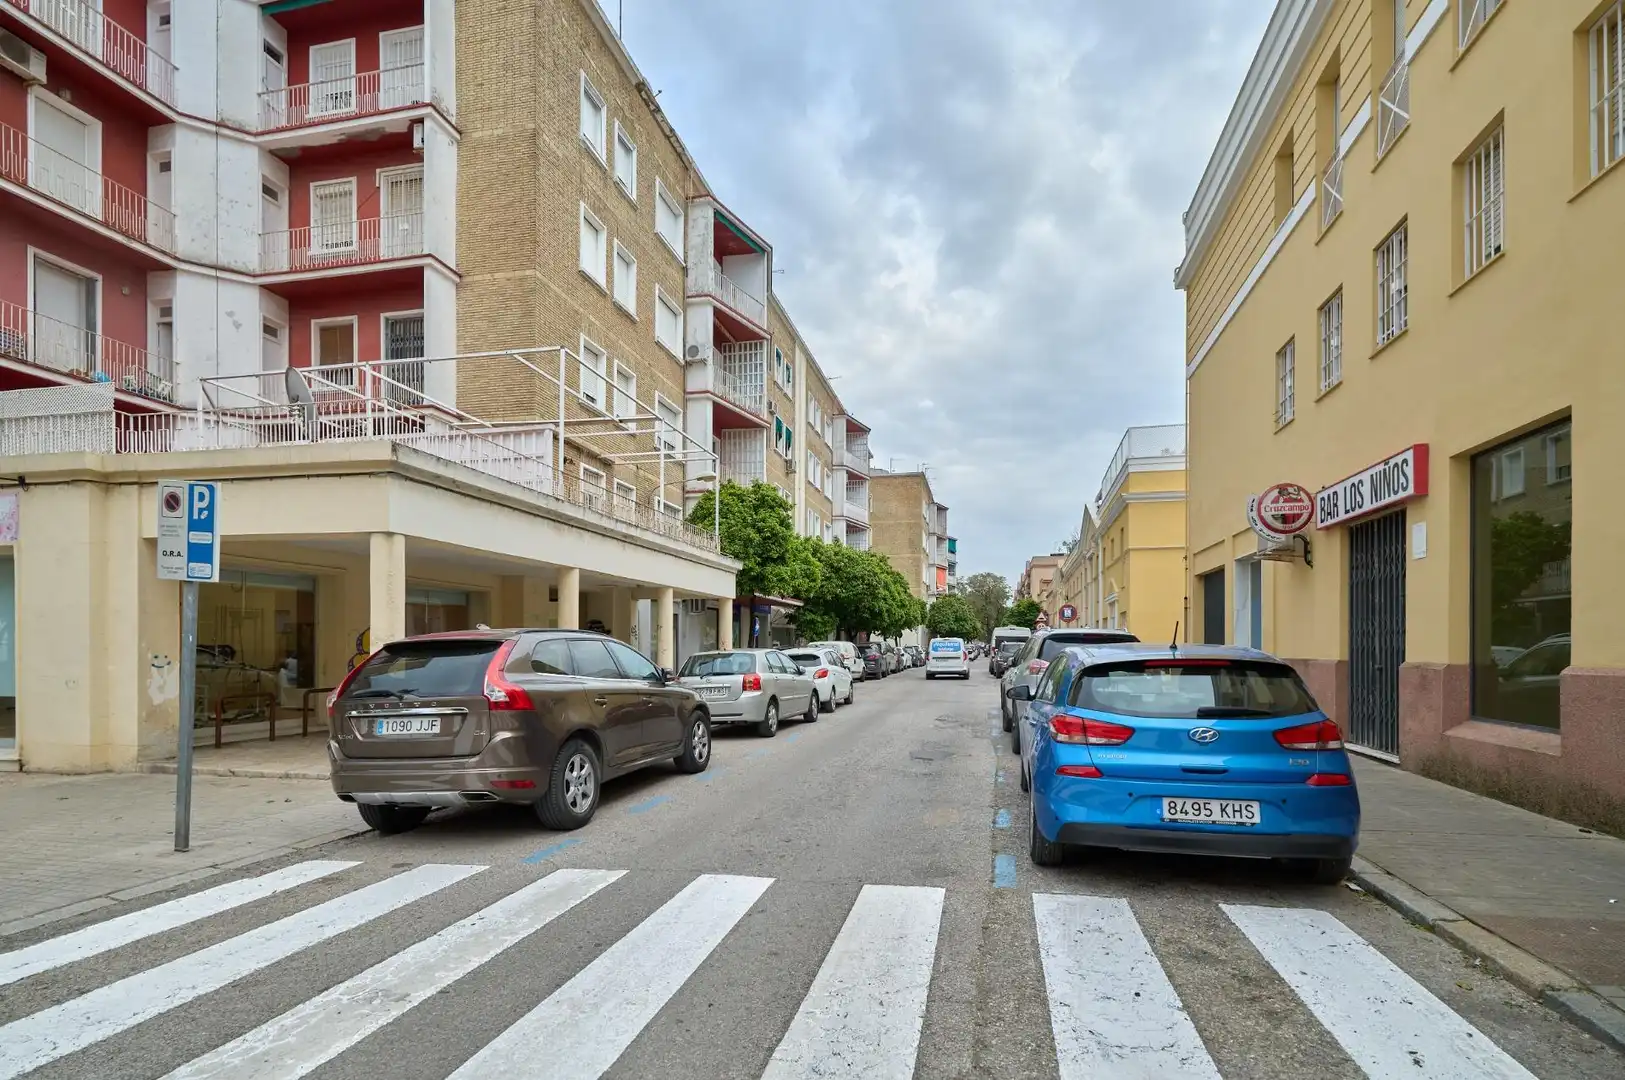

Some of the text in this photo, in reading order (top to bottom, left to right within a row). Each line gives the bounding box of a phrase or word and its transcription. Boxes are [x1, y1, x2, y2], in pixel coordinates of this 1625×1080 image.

[1320, 458, 1409, 523] BAR LOS NIÑOS
[193, 485, 210, 519] P
[1264, 504, 1310, 513] Cruzcampo
[386, 719, 438, 732] 1090 JJF
[1167, 800, 1255, 820] 8495 KHS
